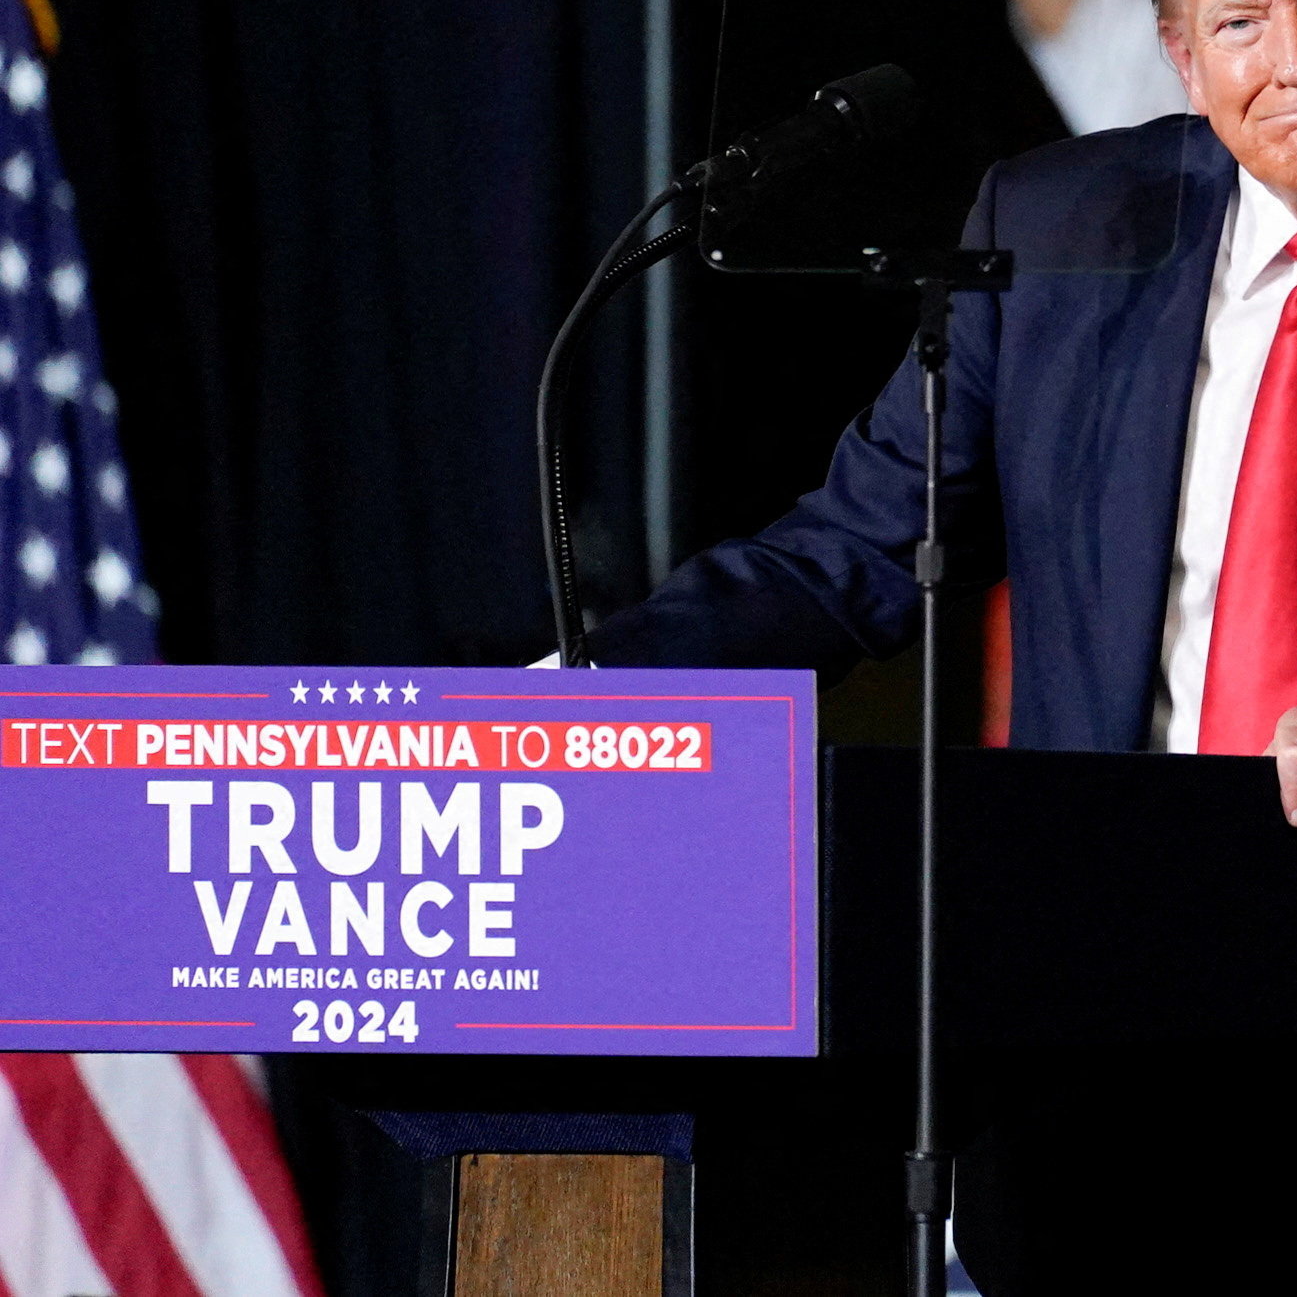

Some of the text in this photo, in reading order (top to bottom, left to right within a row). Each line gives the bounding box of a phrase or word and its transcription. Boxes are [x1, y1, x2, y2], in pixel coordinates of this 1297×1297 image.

[11, 722, 702, 769] TEXT PENNSYLVANIA TO 88022
[146, 780, 565, 875] TRUMP
[193, 880, 516, 957] VANCE
[172, 967, 539, 990] MAKE AMERICA GREAT AGAIN!
[292, 999, 419, 1043] 2024
